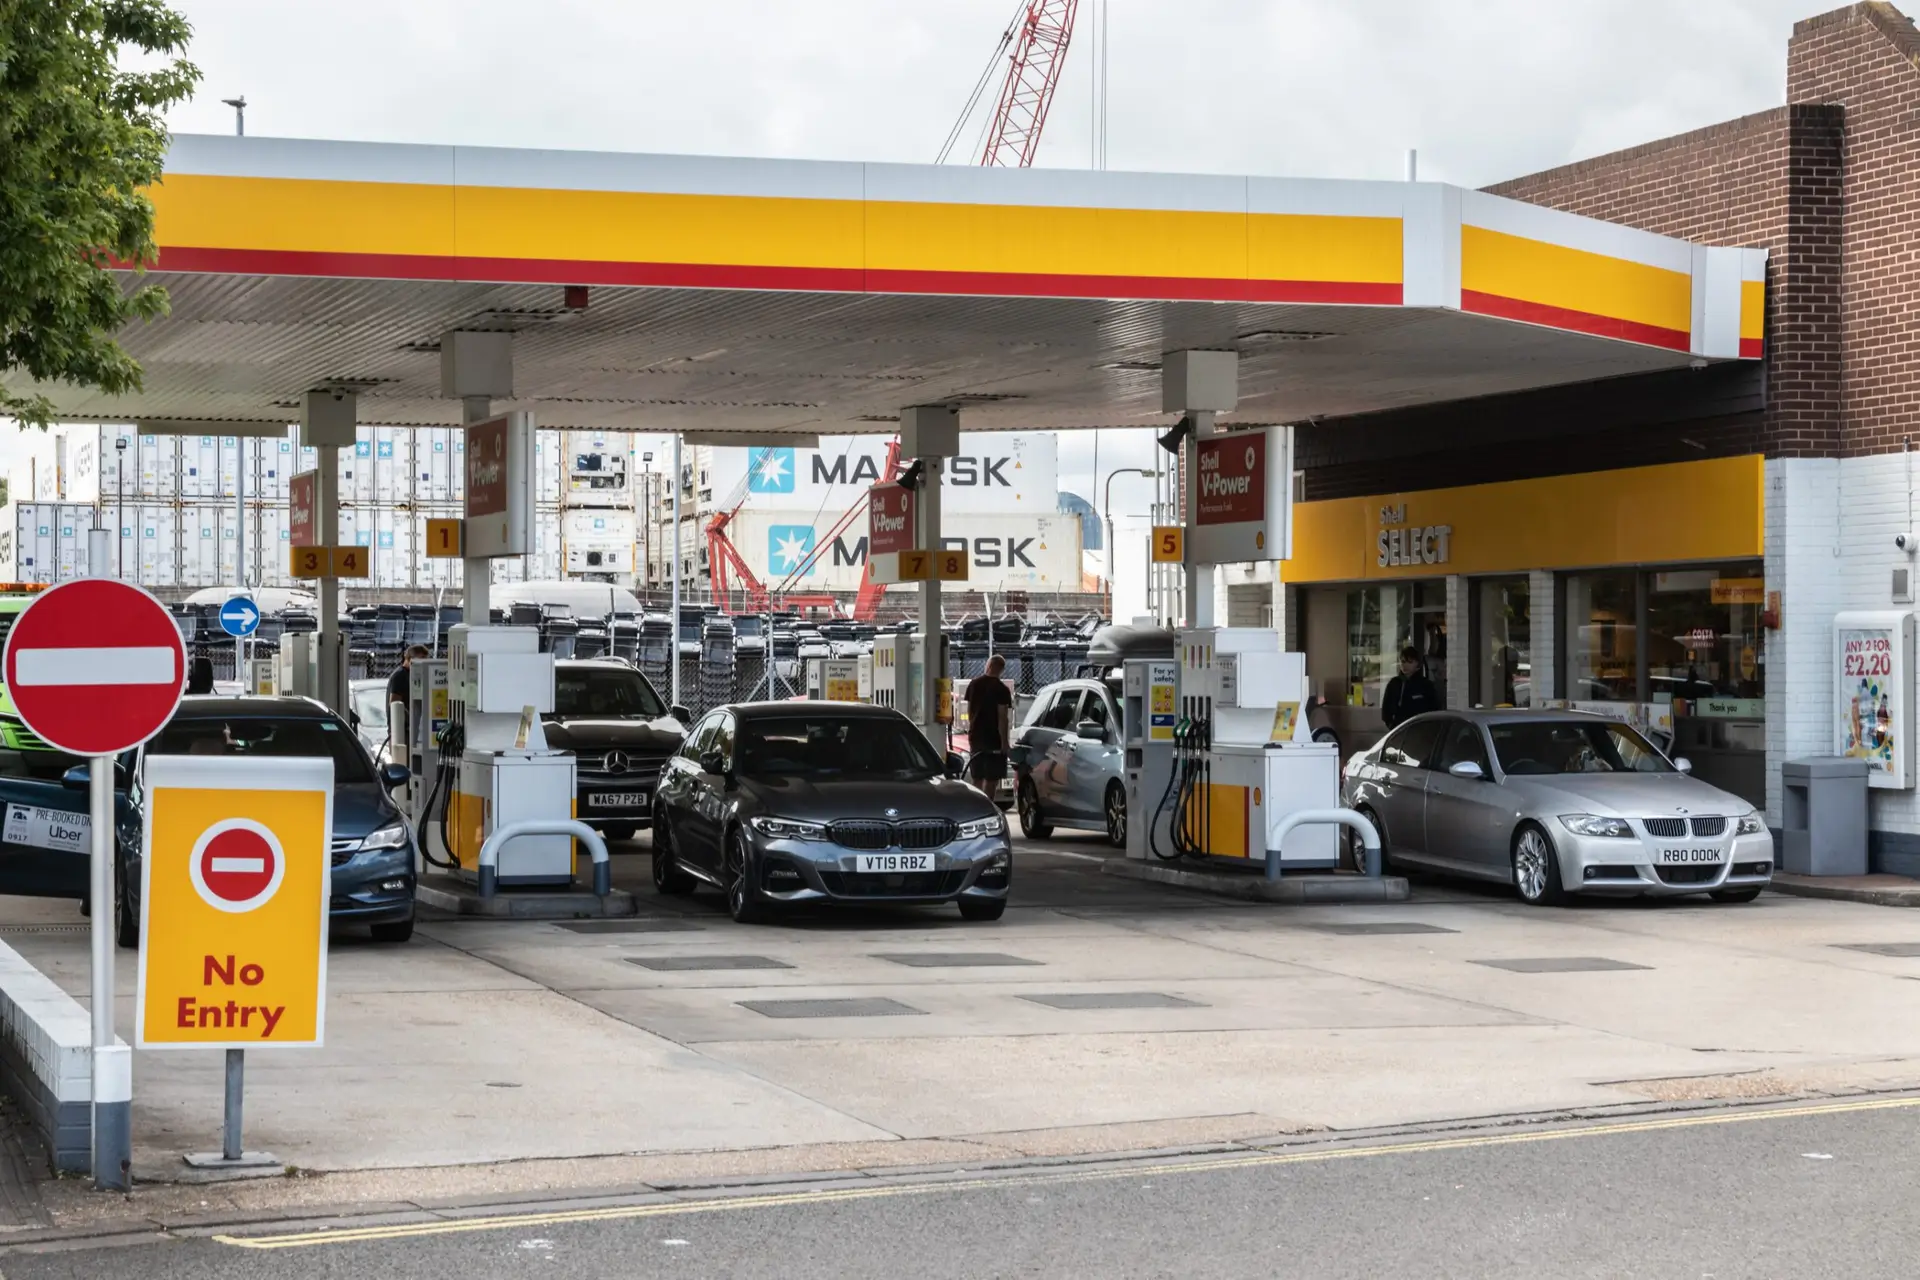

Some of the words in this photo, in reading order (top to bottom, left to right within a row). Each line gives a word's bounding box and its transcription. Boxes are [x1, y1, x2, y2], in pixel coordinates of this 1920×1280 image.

[1201, 450, 1220, 470] Shell
[812, 454, 1011, 487] MASK
[1201, 472, 1250, 497] V-Power
[873, 496, 885, 512] Shell
[1380, 503, 1405, 524] Shell
[873, 513, 905, 533] V-Power
[440, 528, 449, 549] 1
[1162, 534, 1176, 554] 5
[1377, 525, 1451, 568] SELECT
[305, 552, 318, 570] 3
[343, 552, 356, 570] 4
[834, 536, 1036, 568] MSK
[911, 557, 923, 574] 7
[946, 556, 958, 574] 8
[1692, 628, 1714, 640] COSTA
[1845, 640, 1862, 652] ANY
[1866, 640, 1871, 651] 2
[1873, 639, 1890, 651] FOR
[1845, 653, 1890, 676] £2.20
[434, 677, 448, 685] saf
[1709, 702, 1725, 712] Thank
[1727, 706, 1738, 714] you
[594, 794, 621, 805] WA67
[623, 794, 644, 805] PZB
[36, 808, 80, 826] PRE-BOOKED
[81, 815, 92, 827] ON
[8, 833, 28, 841] 0917
[49, 824, 82, 841] Uber
[866, 856, 896, 870] VT19
[900, 855, 927, 869] RBZ
[204, 955, 264, 986] No
[177, 996, 286, 1038] Entry
